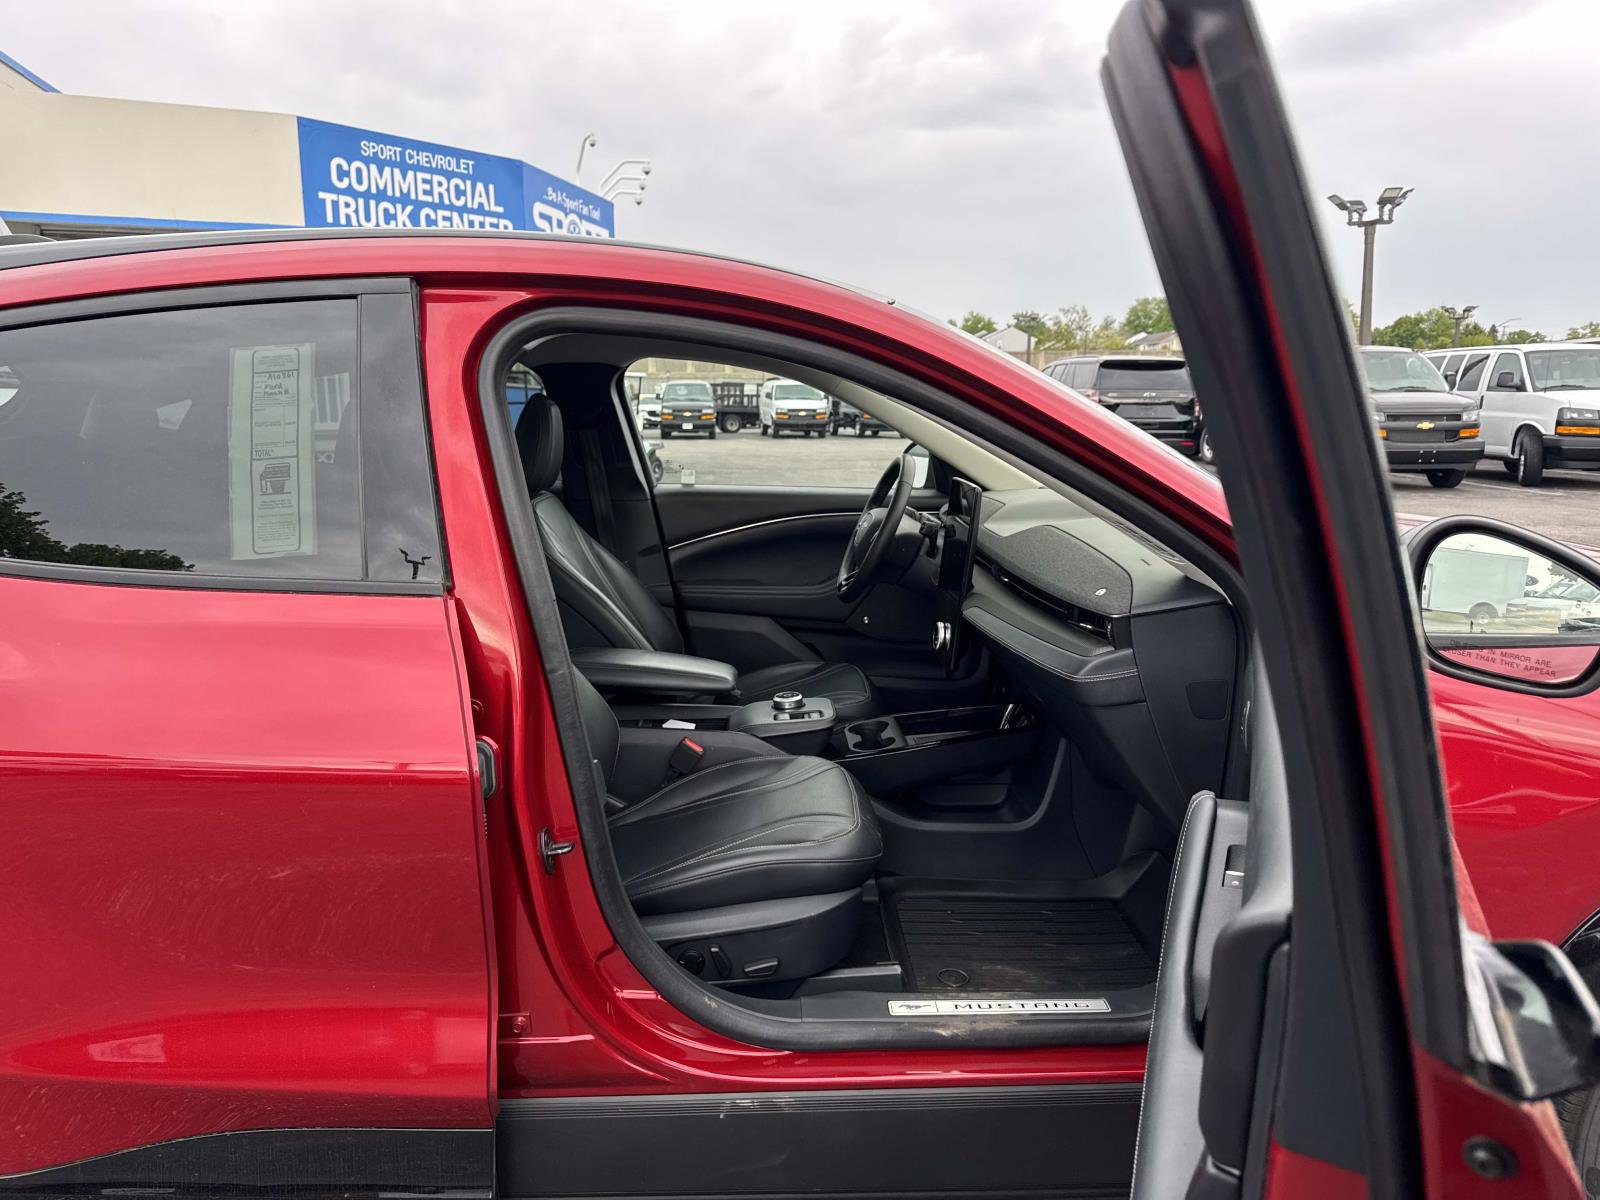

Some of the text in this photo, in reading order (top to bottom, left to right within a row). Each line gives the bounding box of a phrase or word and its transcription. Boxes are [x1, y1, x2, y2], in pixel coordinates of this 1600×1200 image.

[360, 141, 475, 175] SPORT CHEVROLET
[330, 157, 504, 213] COMMERCIAL
[318, 191, 415, 229] TRUCK
[1475, 653, 1496, 663] THAN
[1500, 659, 1520, 669] THEY
[1523, 665, 1556, 676] APPEAR
[1500, 651, 1531, 663] MIRROR
[1535, 659, 1552, 667] ARE
[954, 1002, 1089, 1010] MUSTANG
